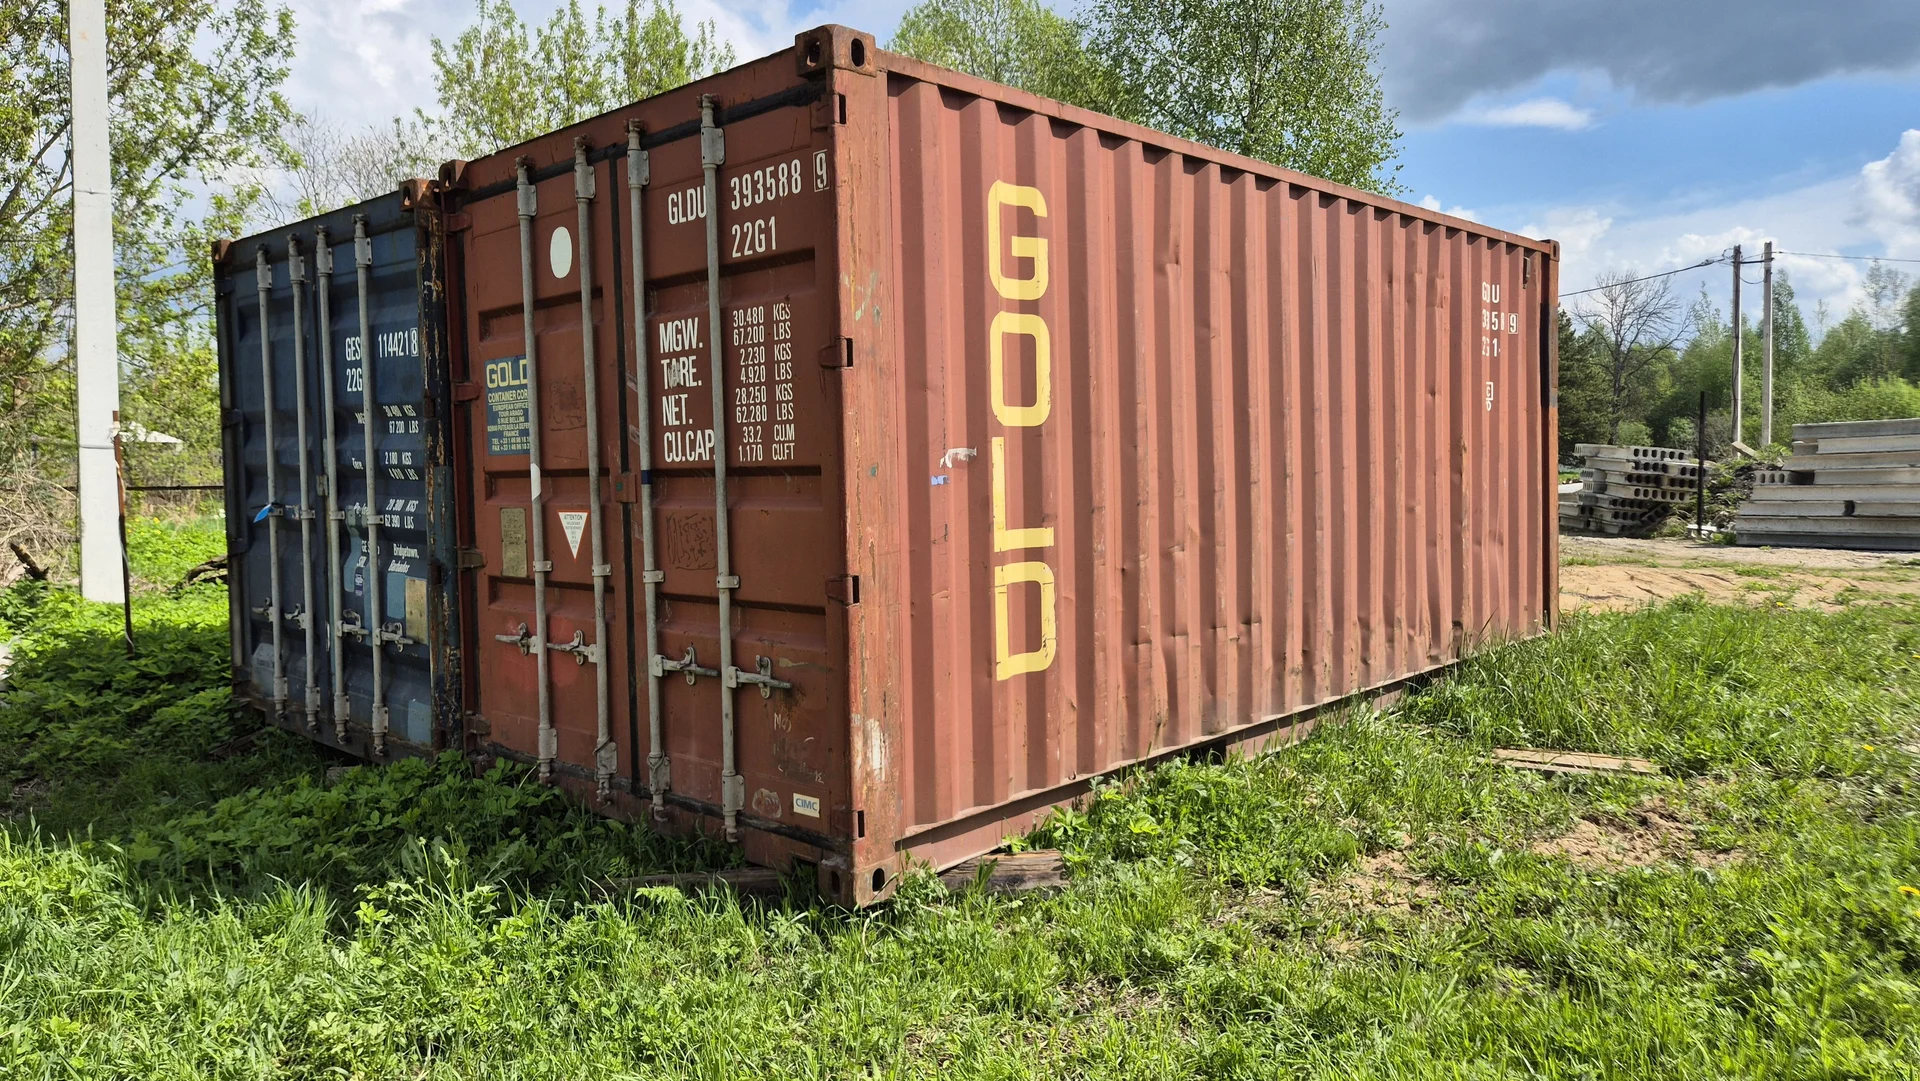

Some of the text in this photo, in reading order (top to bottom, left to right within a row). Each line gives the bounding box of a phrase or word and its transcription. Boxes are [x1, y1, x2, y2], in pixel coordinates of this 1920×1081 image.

[668, 151, 828, 225] GLDU 393588 9
[732, 216, 776, 258] 22G1
[733, 303, 791, 328] 30.480 KGS
[1509, 313, 1518, 334] 9
[659, 317, 703, 354] MGW.
[734, 322, 791, 346] 67.200 LBS
[346, 336, 362, 361] GES
[378, 330, 409, 358] 114421
[740, 343, 792, 365] 2.230 KGS
[346, 368, 363, 392] 22G
[486, 358, 528, 389] GOLD
[661, 356, 702, 390] TARE.
[740, 362, 792, 384] 4.920 LBS
[488, 389, 529, 403] CONTAINER COR
[736, 384, 793, 405] 28.250 KGS
[493, 404, 514, 412] EUROPEAN
[662, 394, 693, 426] NET.
[736, 403, 794, 424] 62.280 LBS
[409, 420, 419, 434] LBS
[743, 424, 795, 443] 33.2 CU.M
[988, 180, 1057, 681] GOLD
[402, 452, 412, 465] KGS
[739, 443, 795, 462] 1.170 CU.FT
[404, 516, 414, 529] LBS
[795, 798, 818, 811] CIMC
